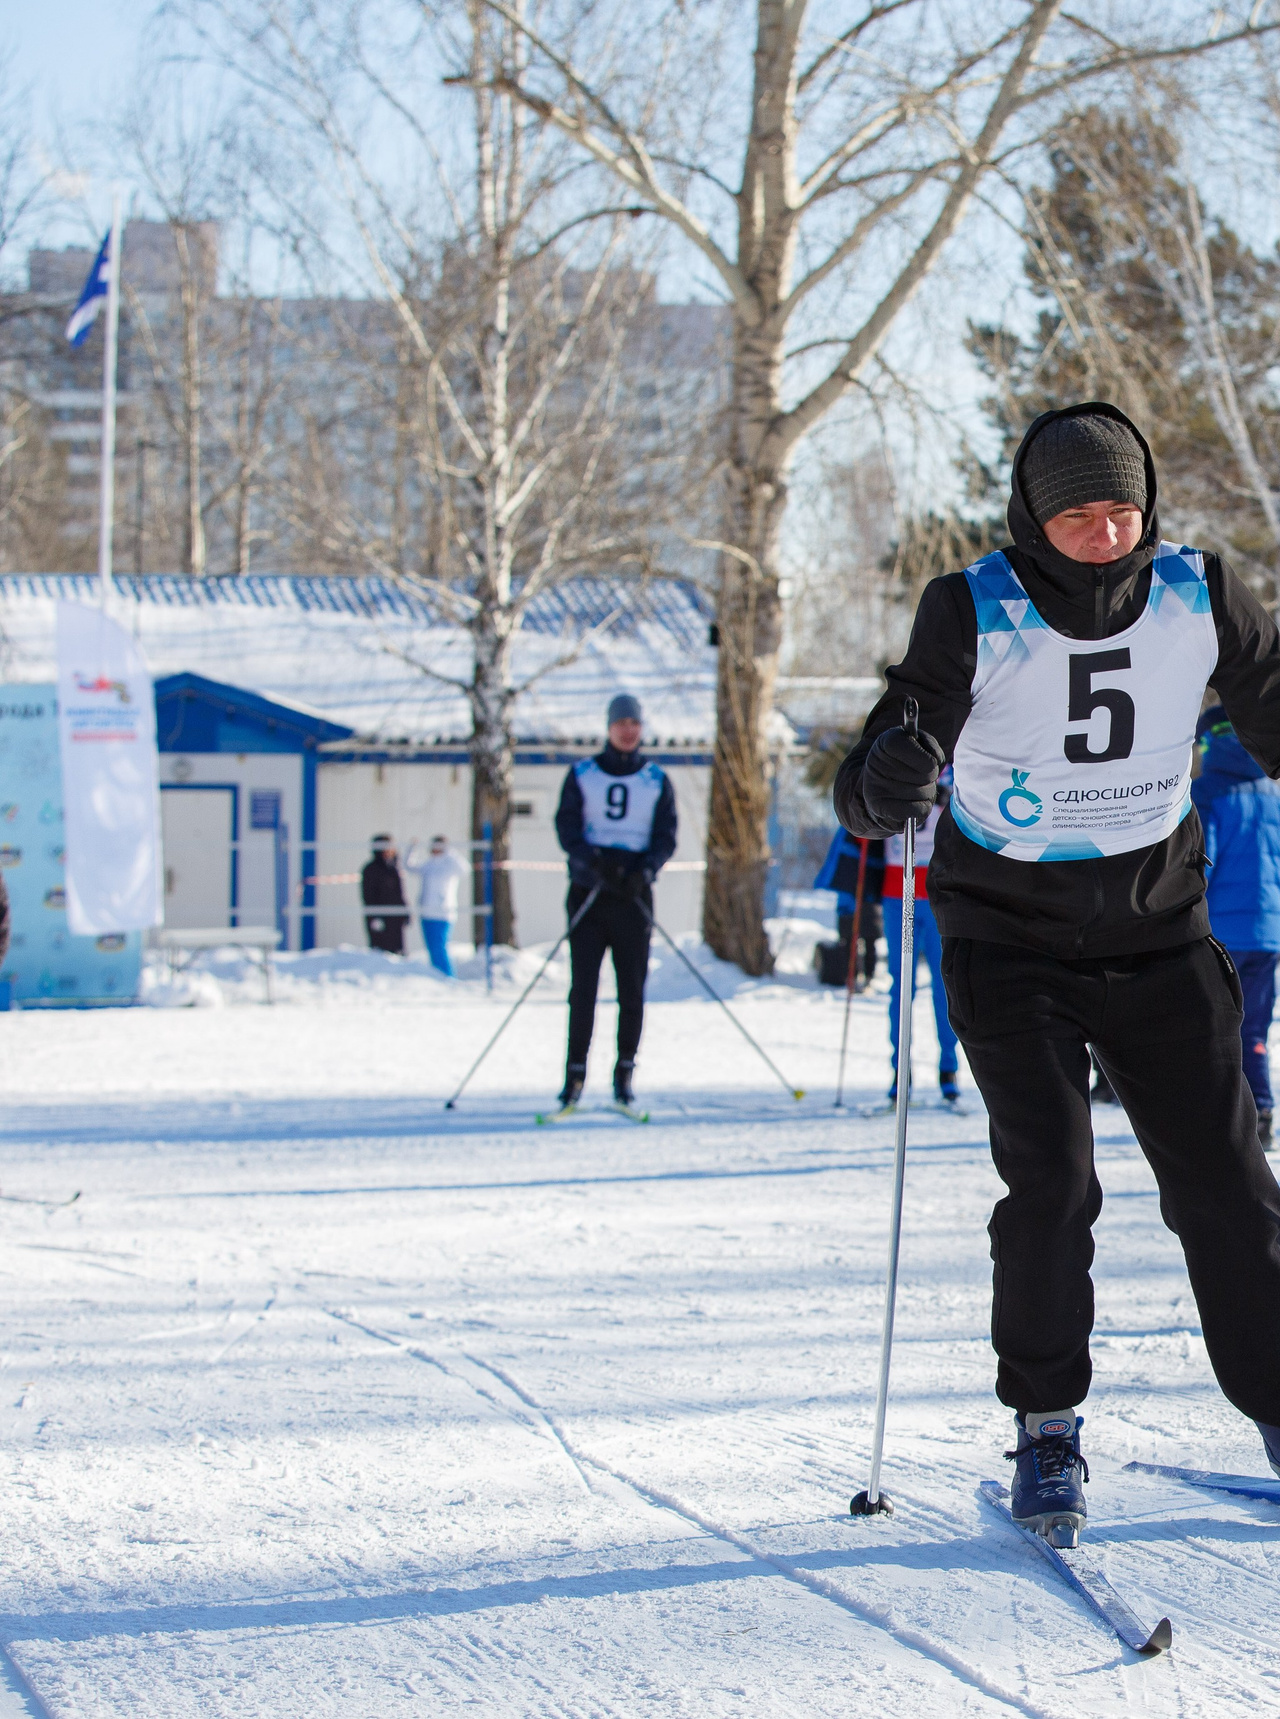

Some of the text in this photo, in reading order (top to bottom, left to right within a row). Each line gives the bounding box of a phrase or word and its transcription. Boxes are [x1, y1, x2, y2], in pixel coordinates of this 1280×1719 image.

[1064, 647, 1135, 764] 5
[1053, 774, 1180, 804] СДЮСШОР №2
[606, 782, 628, 820] 9
[1053, 804, 1128, 814] Специализированная
[1052, 813, 1121, 822] детско-юношеская
[1121, 806, 1156, 818] спортивная
[1052, 818, 1132, 829] олимпийского резерва
